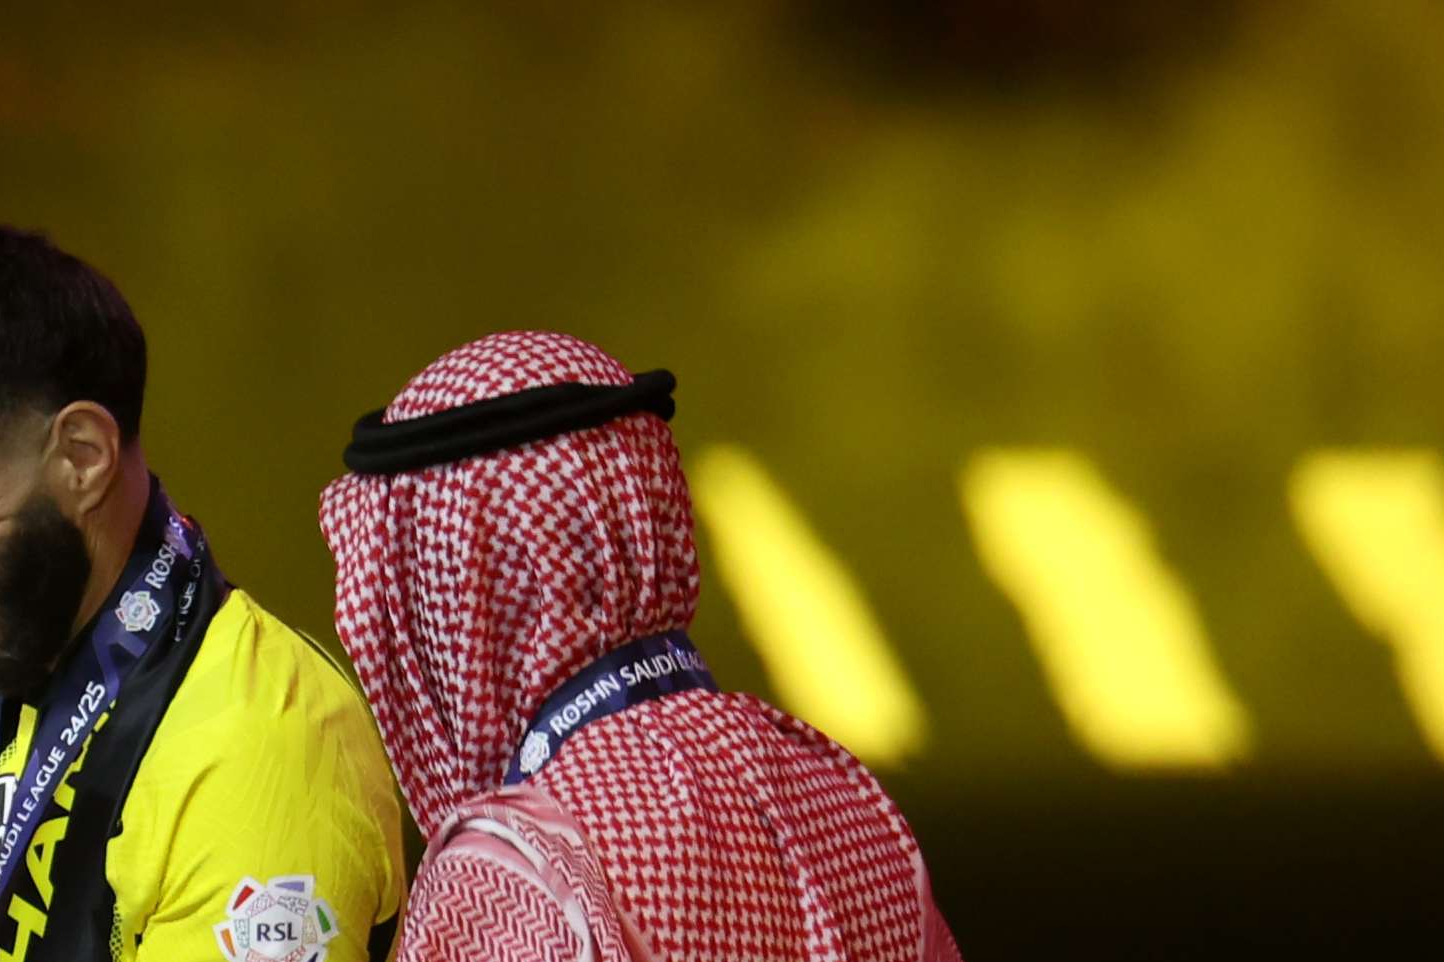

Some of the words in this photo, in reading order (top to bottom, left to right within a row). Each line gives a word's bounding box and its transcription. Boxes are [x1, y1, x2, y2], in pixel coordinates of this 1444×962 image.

[144, 542, 179, 589] ROSH
[549, 673, 621, 737] ROSHN
[619, 651, 678, 687] SAUDI
[22, 745, 66, 823] LEAGUE
[60, 680, 106, 746] 24/25
[256, 921, 298, 942] RSL
